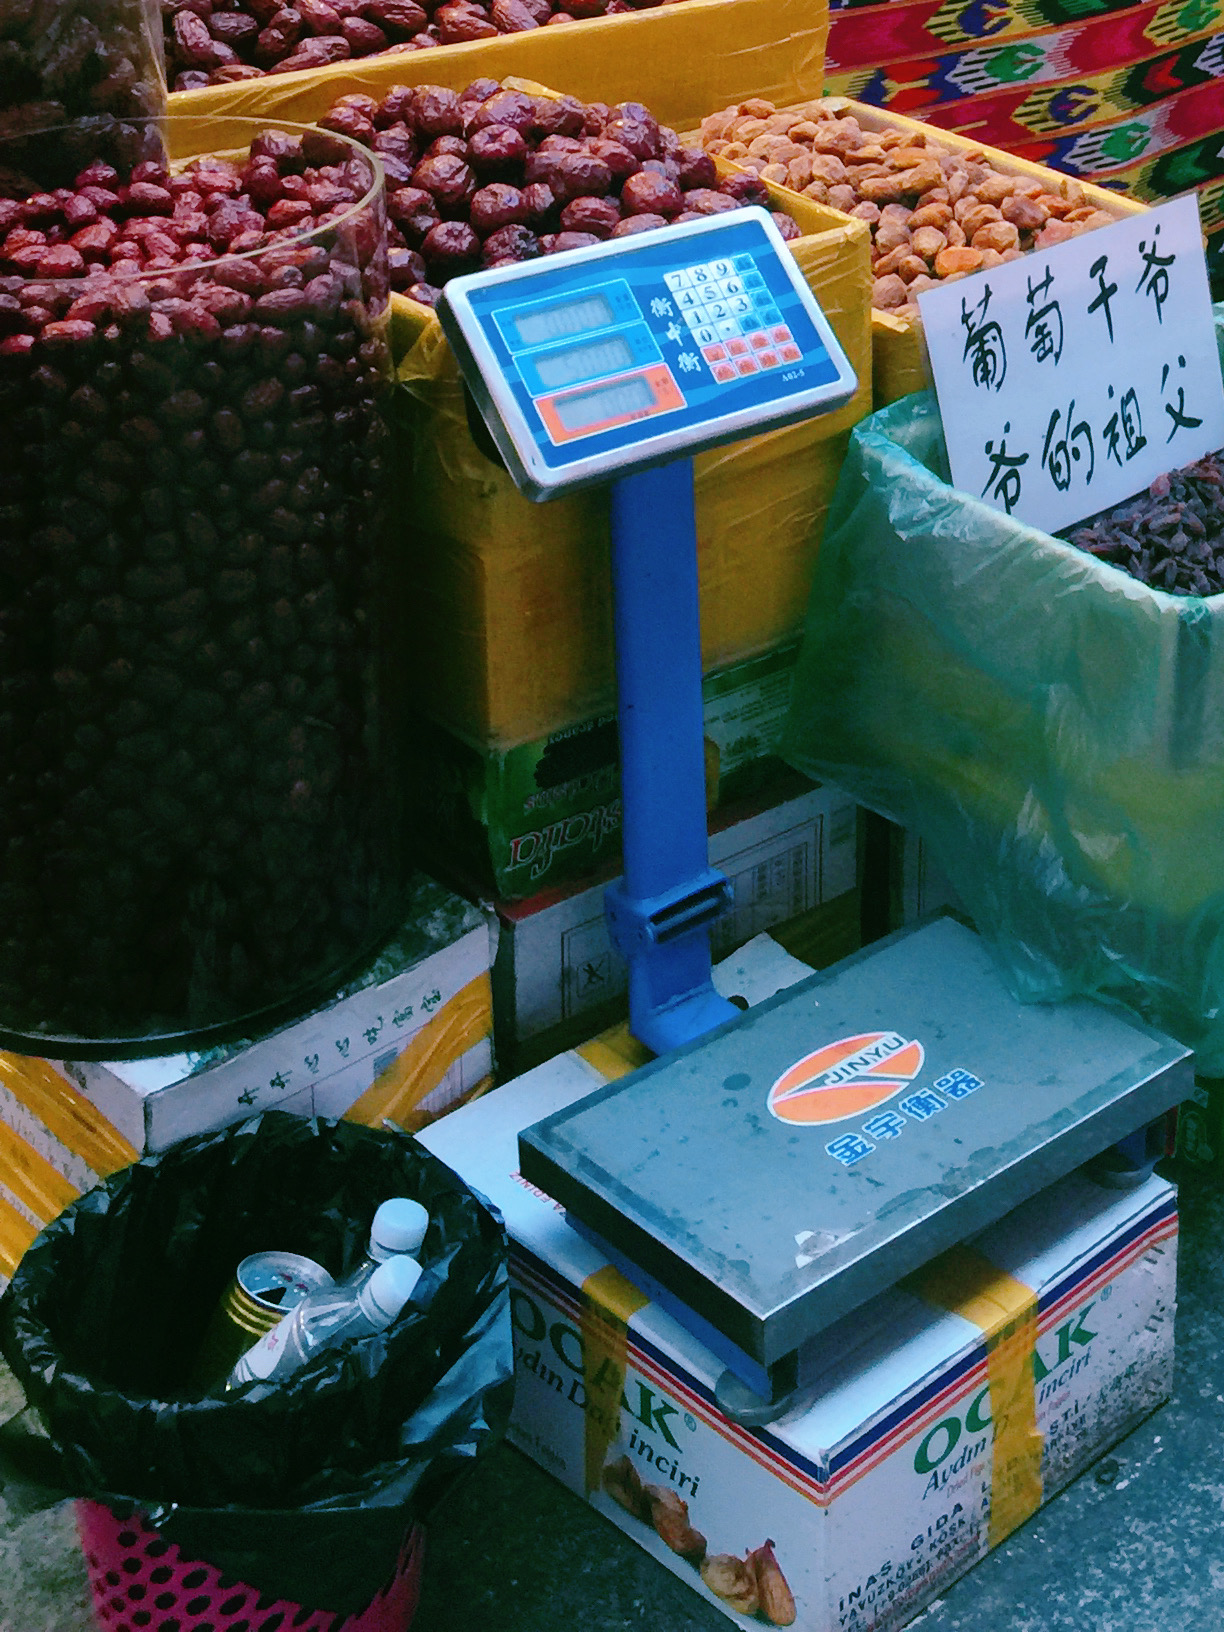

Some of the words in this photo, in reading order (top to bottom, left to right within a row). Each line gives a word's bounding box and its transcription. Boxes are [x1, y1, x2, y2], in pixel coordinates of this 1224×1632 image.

[961, 224, 1175, 392] 葡萄干爷
[981, 355, 1203, 516] 爷的祖父
[825, 1036, 905, 1085] JINYU
[825, 1068, 985, 1167] 金宇衡器
[629, 1428, 701, 1499] inciri
[910, 1501, 965, 1552] GIDA
